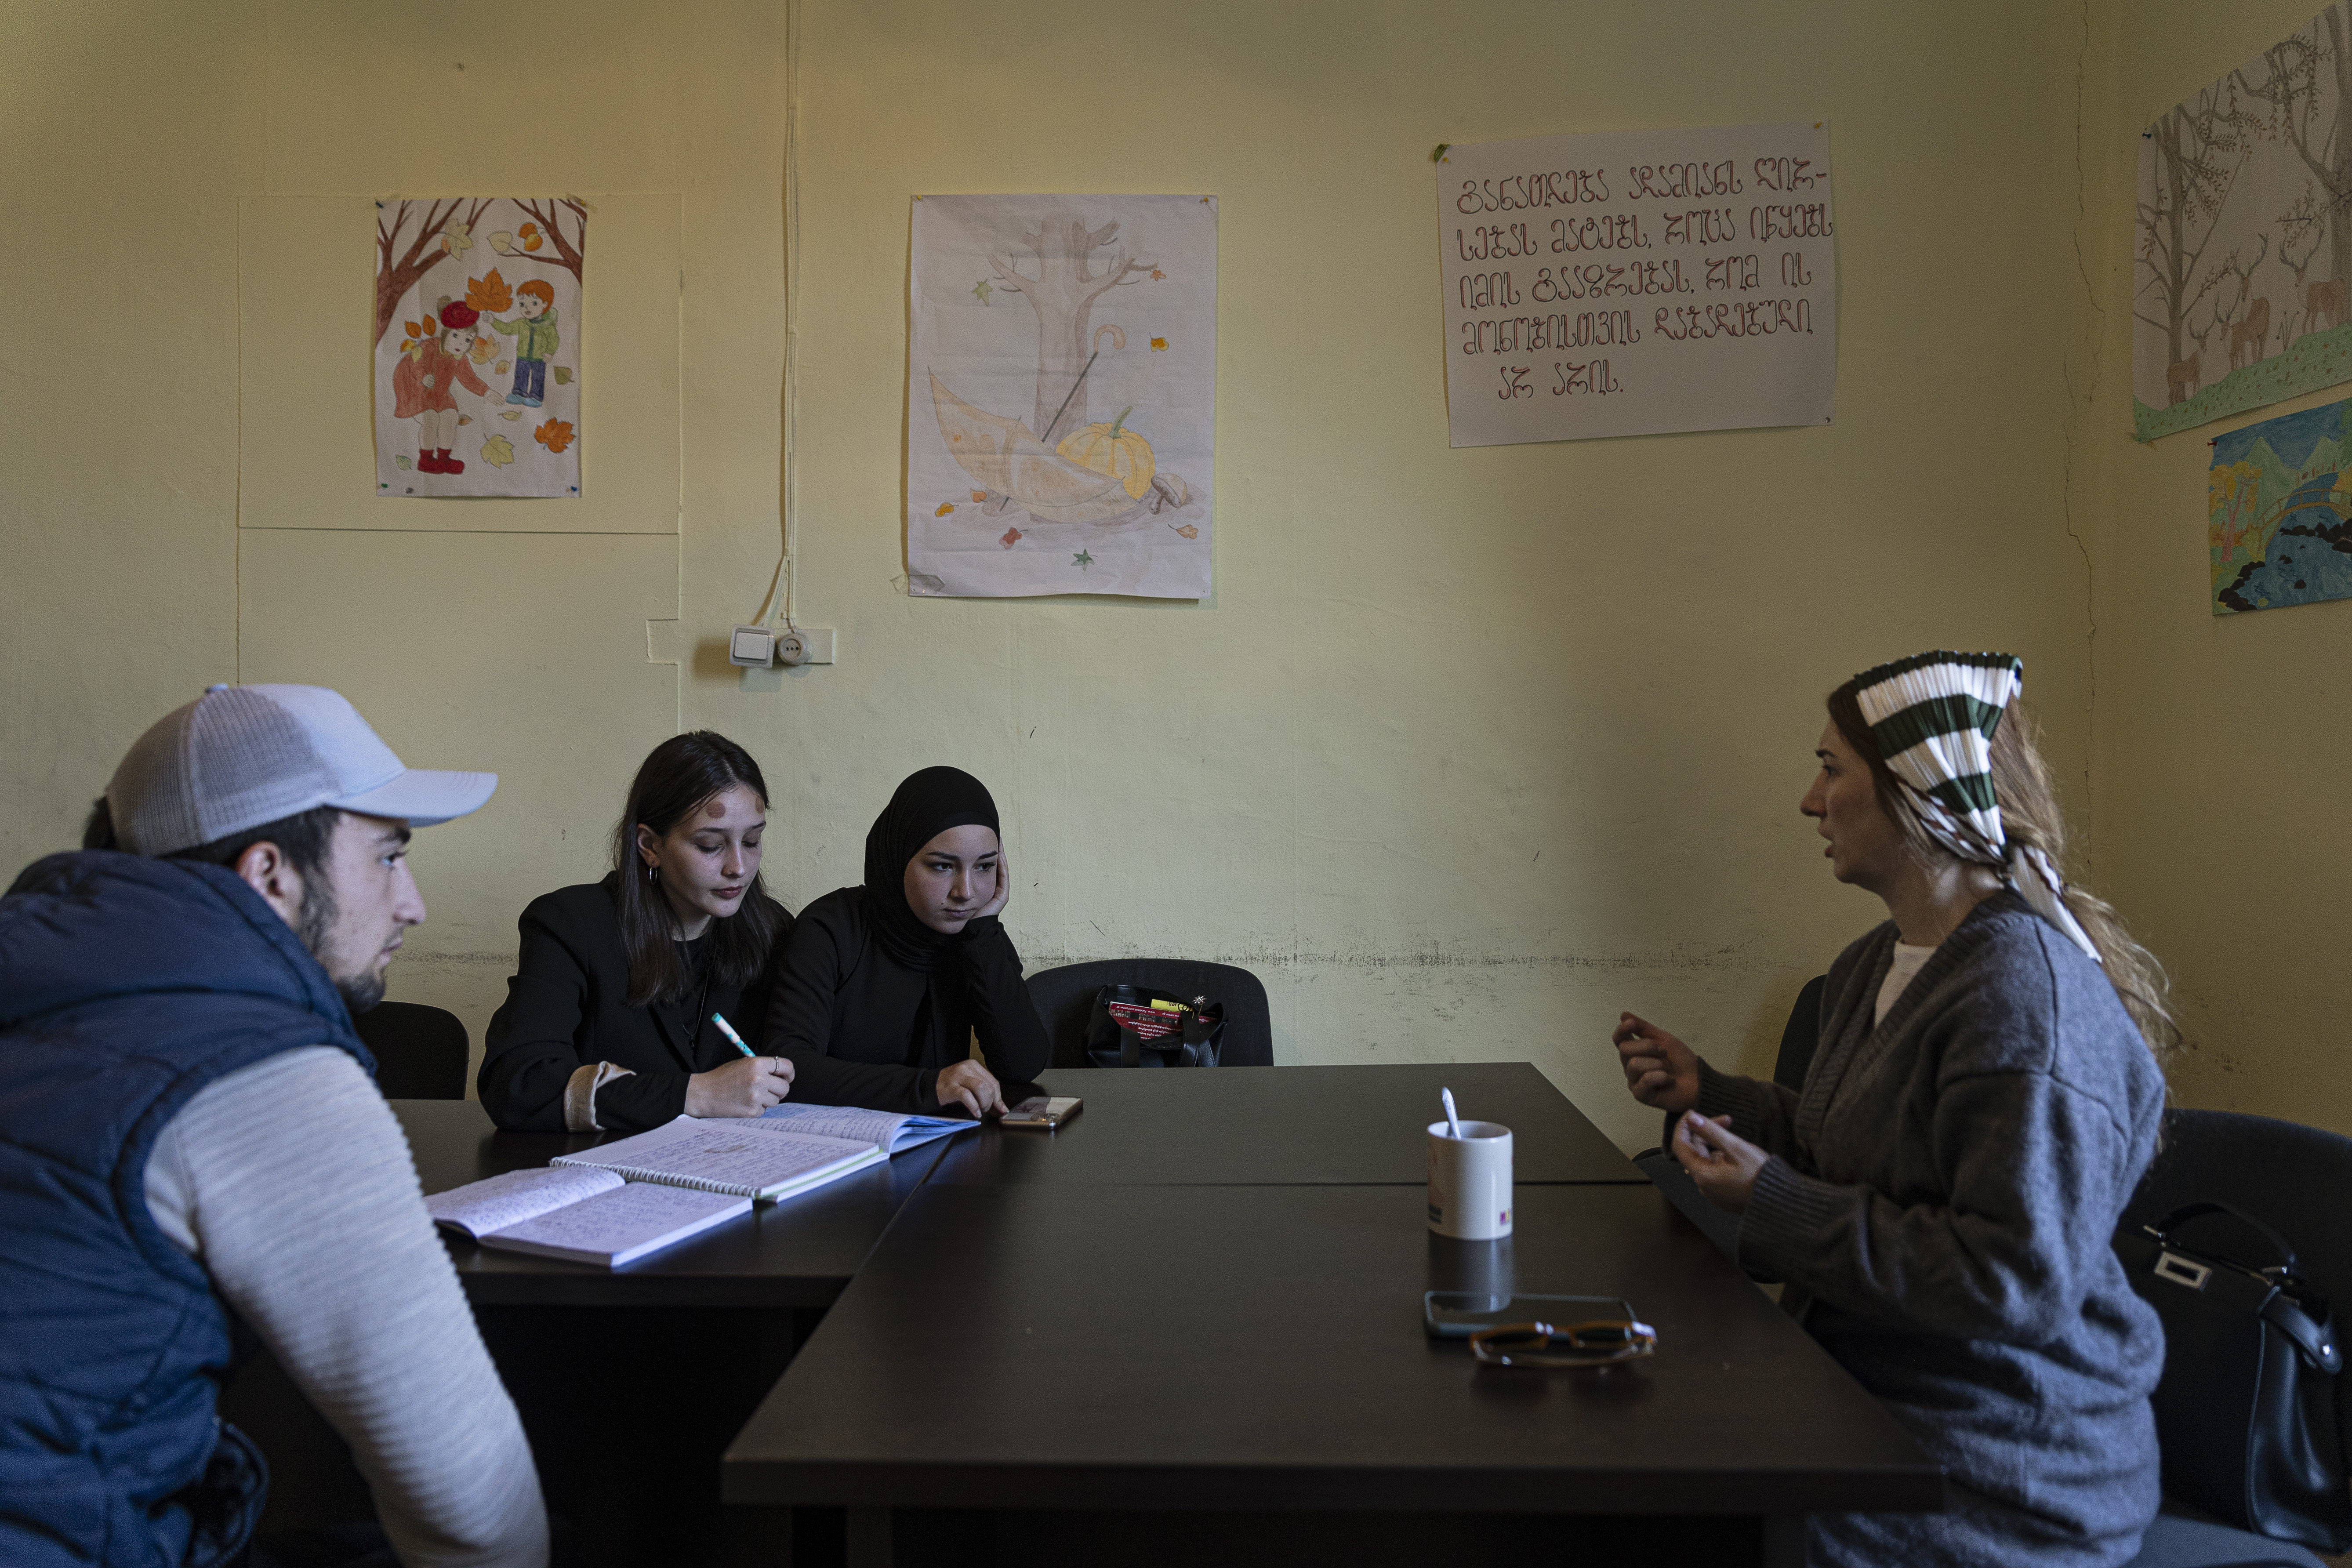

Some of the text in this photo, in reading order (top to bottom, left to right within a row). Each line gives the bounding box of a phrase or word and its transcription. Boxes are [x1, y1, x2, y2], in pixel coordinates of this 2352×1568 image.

[1456, 168, 1609, 215] განათლება
[1628, 160, 1743, 200] ადამიანს
[1456, 223, 1538, 261] სებას
[1663, 208, 1735, 246] როცა
[1749, 203, 1833, 243] იწყებს
[1459, 271, 1521, 311] იმის
[1705, 254, 1760, 292] რომ
[1782, 252, 1812, 288] ის
[1461, 298, 1813, 356] მონობისთვის დაბადებული
[1498, 366, 1534, 400] არ
